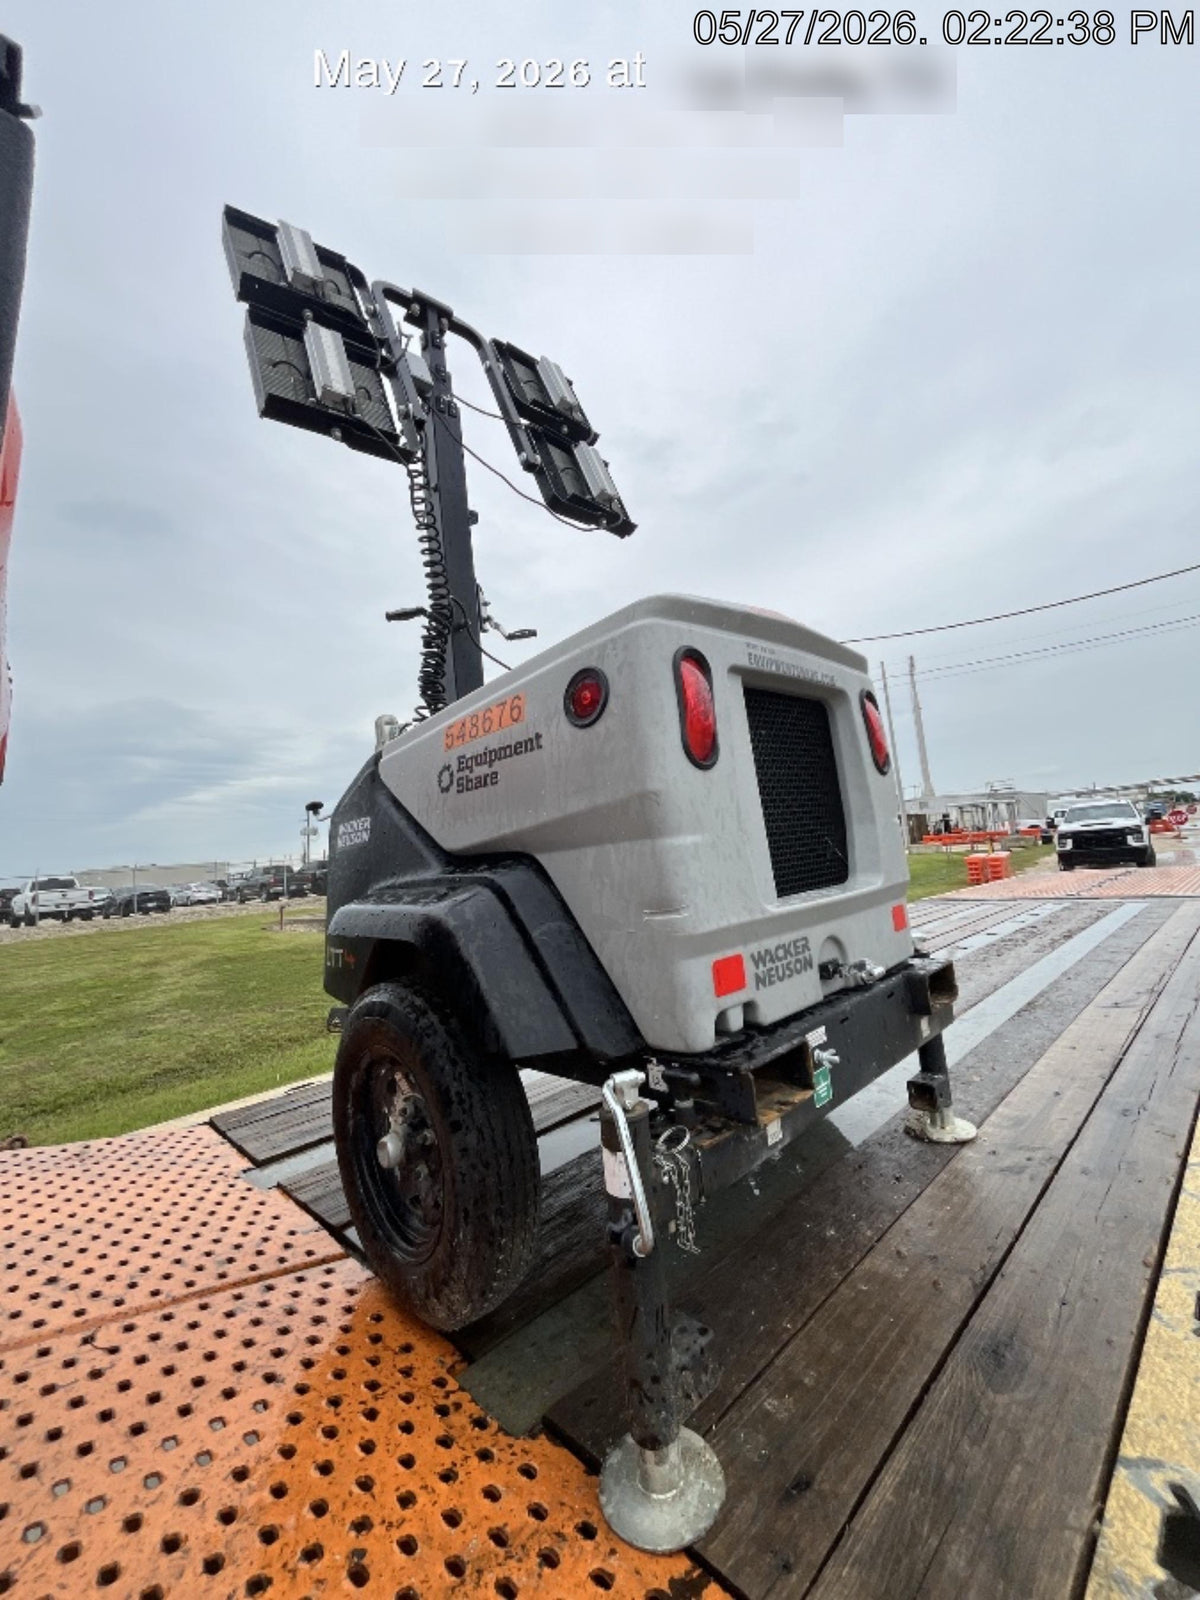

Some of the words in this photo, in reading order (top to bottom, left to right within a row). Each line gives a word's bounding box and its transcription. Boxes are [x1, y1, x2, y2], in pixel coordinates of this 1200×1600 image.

[445, 694, 523, 751] 548676
[456, 731, 543, 774] Equipment
[456, 770, 499, 794] Share
[750, 936, 811, 971] WACKER
[754, 952, 814, 991] NEUSON
